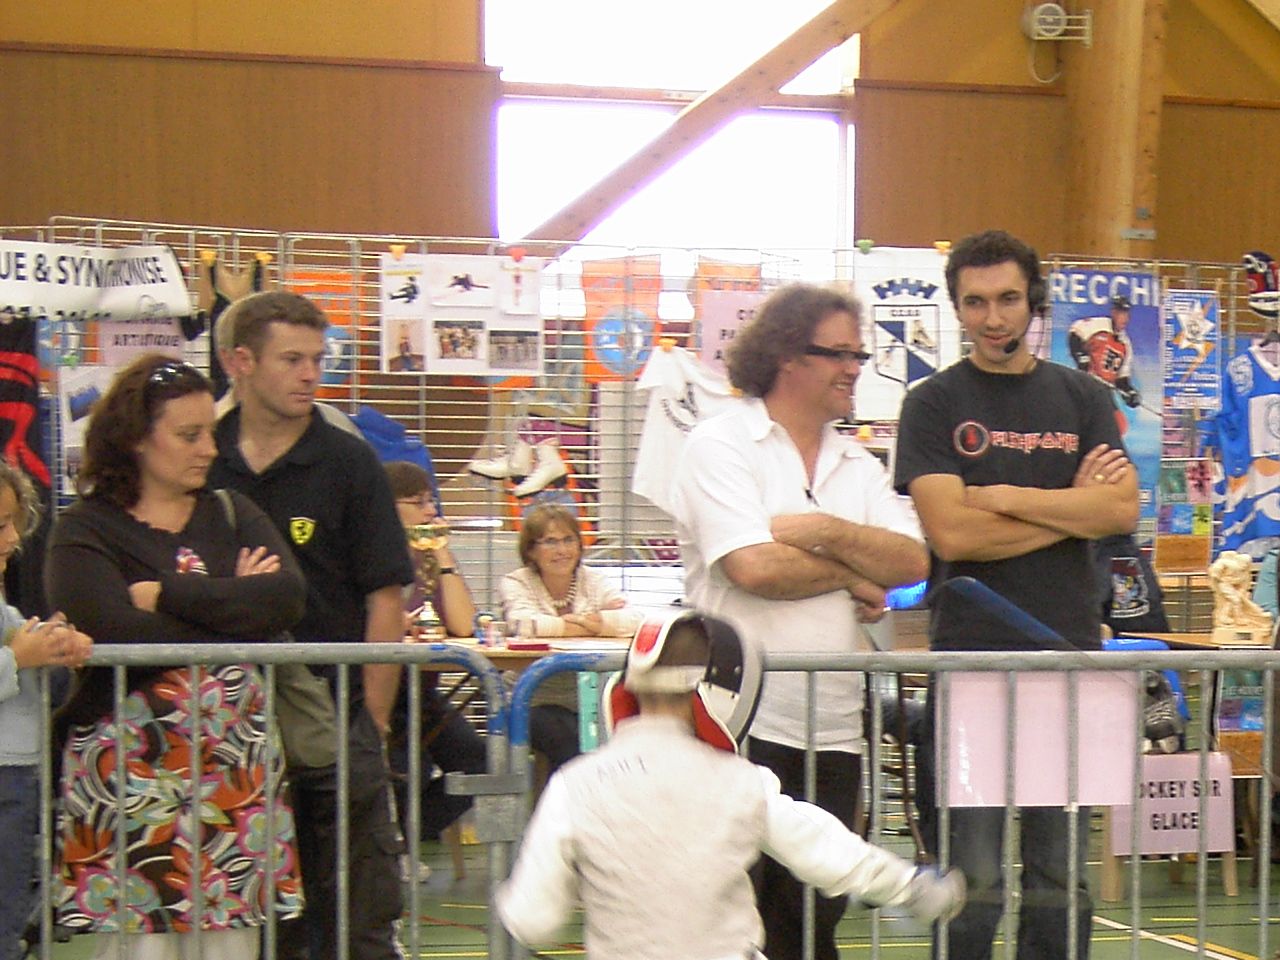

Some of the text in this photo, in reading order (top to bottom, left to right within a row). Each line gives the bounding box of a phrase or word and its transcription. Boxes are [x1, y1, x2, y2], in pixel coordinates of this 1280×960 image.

[1050, 273, 1160, 307] RECCHI
[1139, 780, 1187, 799] OCKEY
[1150, 812, 1200, 831] GLACE
